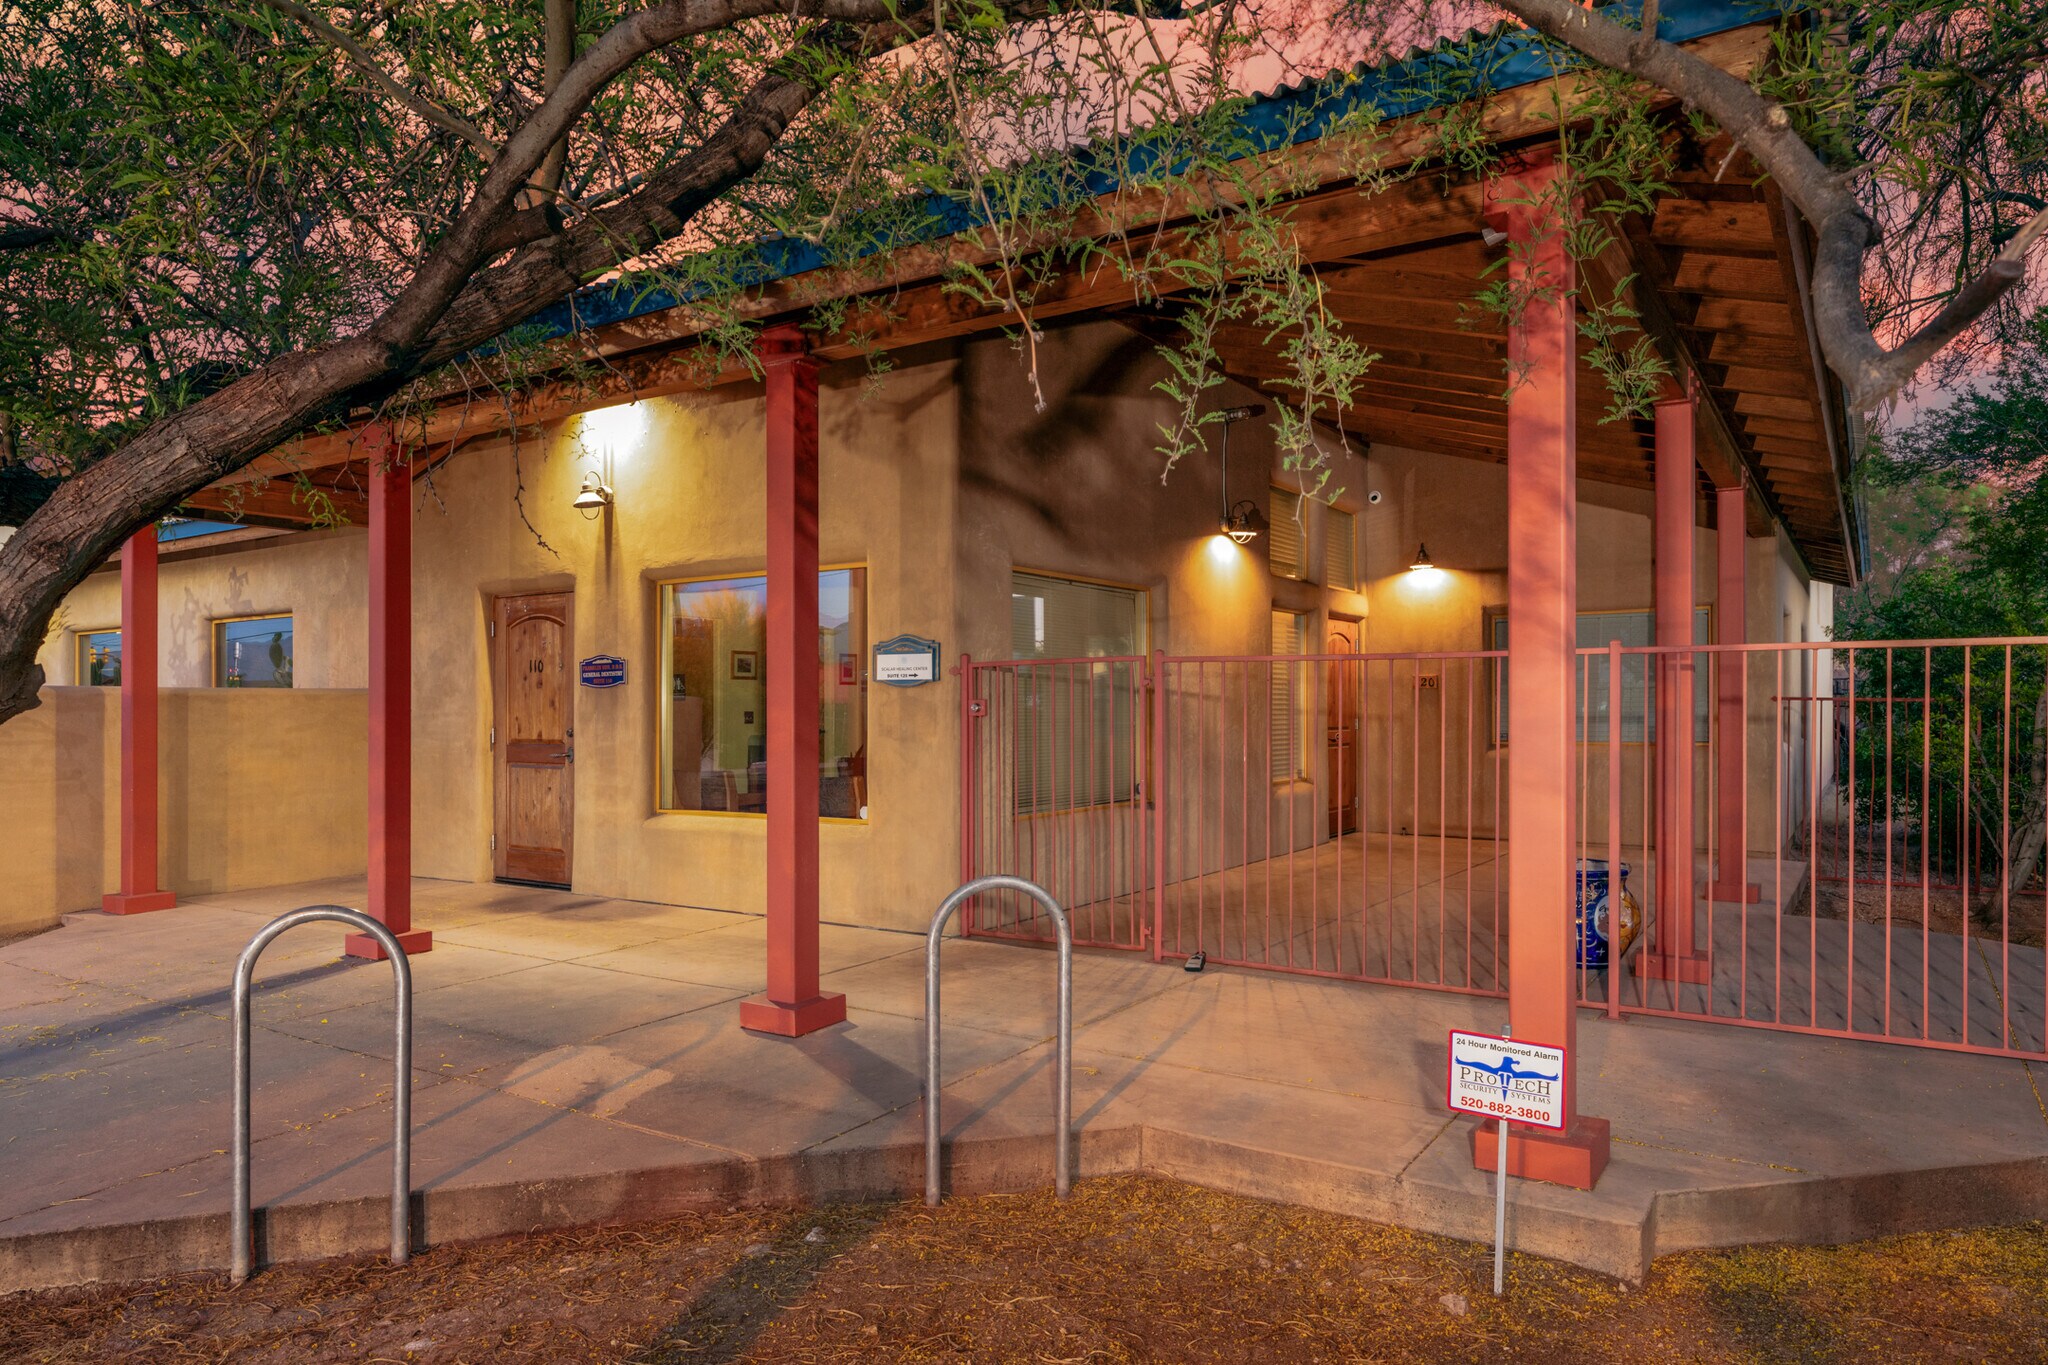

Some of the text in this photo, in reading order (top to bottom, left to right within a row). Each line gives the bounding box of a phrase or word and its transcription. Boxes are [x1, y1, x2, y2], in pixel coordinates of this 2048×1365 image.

[529, 659, 544, 673] 110
[1416, 677, 1435, 687] 20
[1456, 1037, 1559, 1062] 24 Hour Monitored Alarm
[1459, 1082, 1551, 1105] SECURITY SYSTEMS
[1460, 1096, 1551, 1122] 520-882-3800
